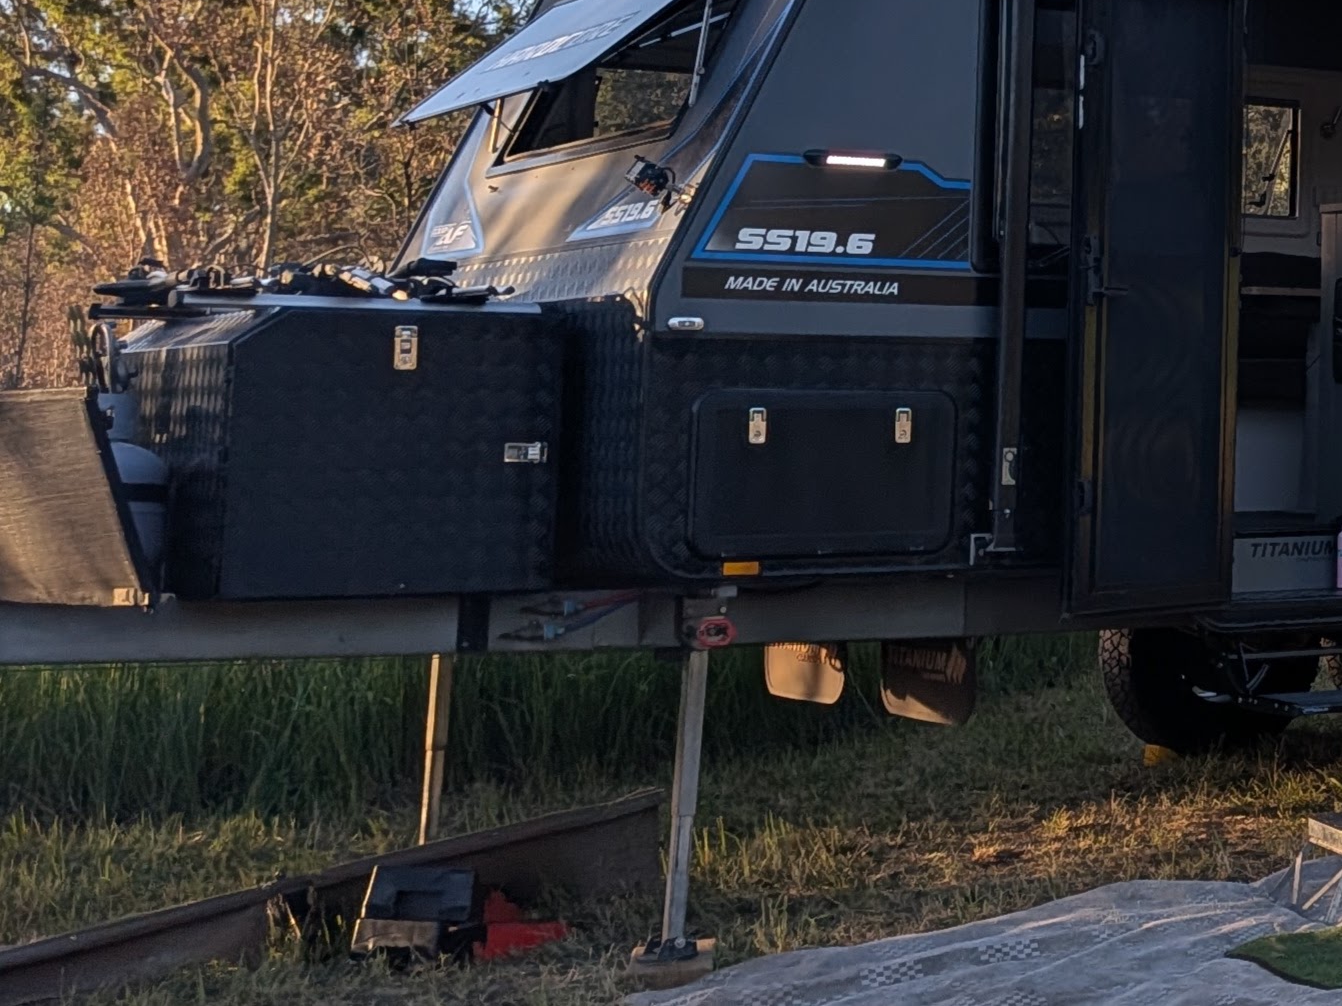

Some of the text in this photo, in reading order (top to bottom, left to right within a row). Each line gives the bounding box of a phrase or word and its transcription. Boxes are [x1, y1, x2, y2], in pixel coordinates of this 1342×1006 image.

[602, 199, 660, 227] SS19.6
[734, 227, 877, 255] SS19.6
[724, 275, 900, 295] MADE IN AUSTRALIA
